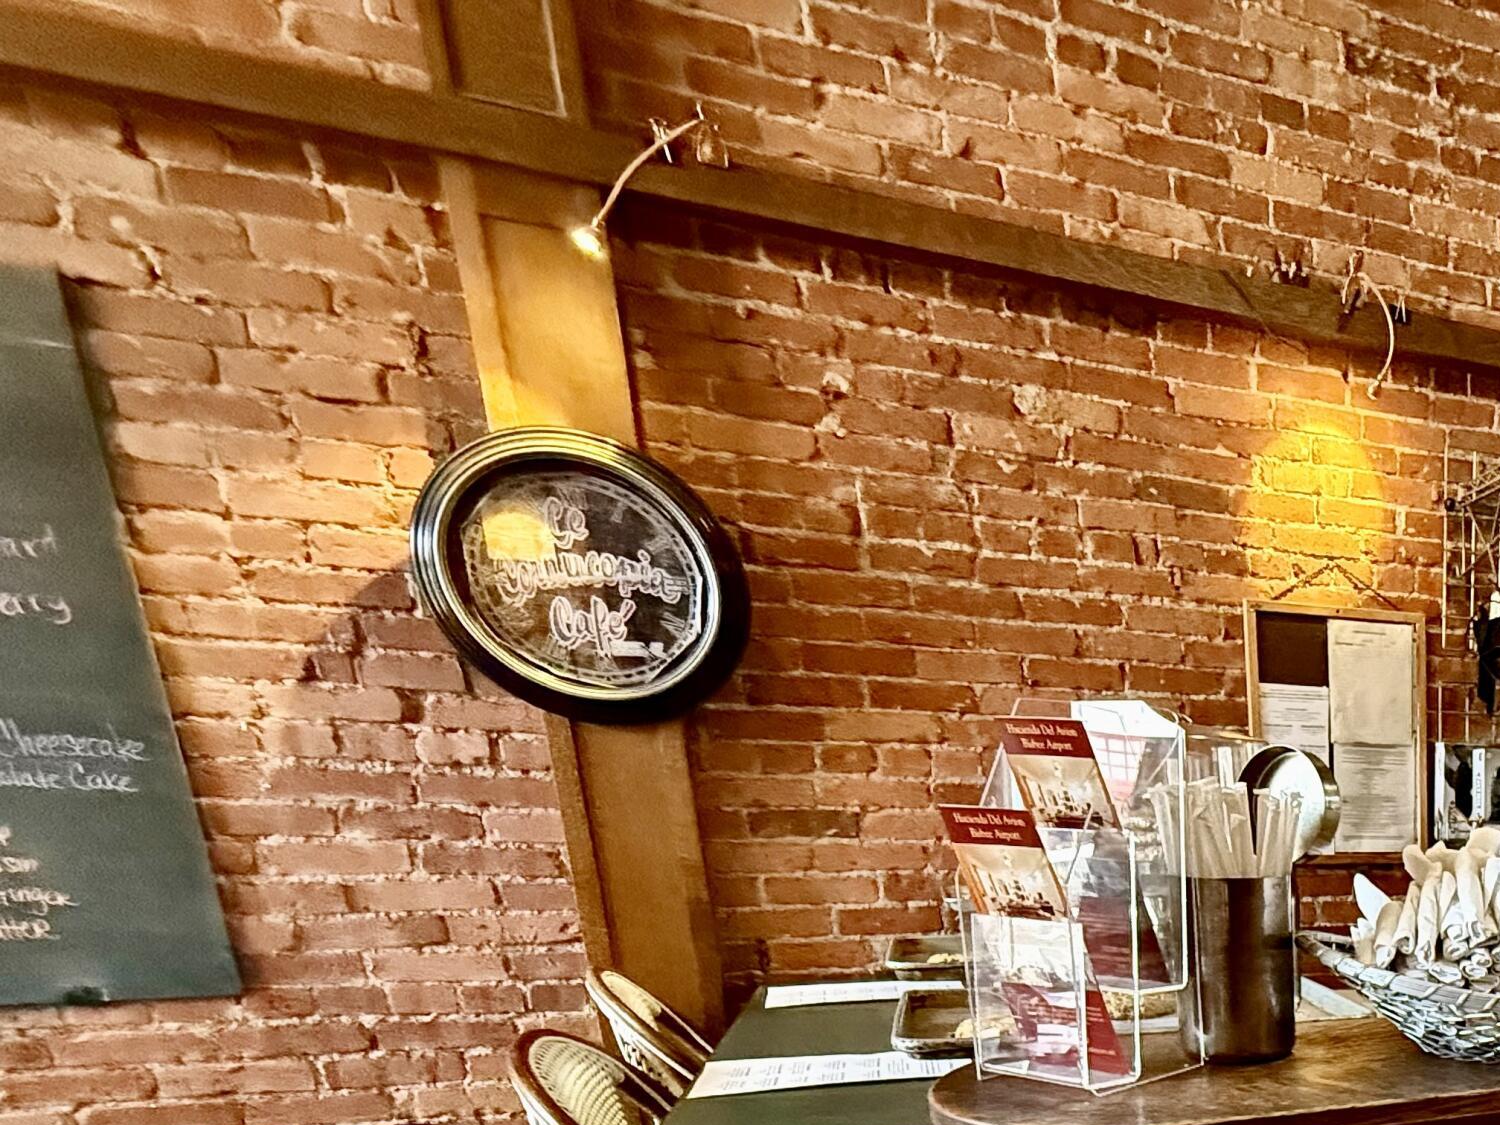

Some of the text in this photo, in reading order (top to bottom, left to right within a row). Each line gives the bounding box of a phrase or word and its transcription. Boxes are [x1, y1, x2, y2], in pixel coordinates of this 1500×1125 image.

[548, 595, 636, 660] Café
[1040, 723, 1056, 736] Del
[69, 761, 140, 793] Cake
